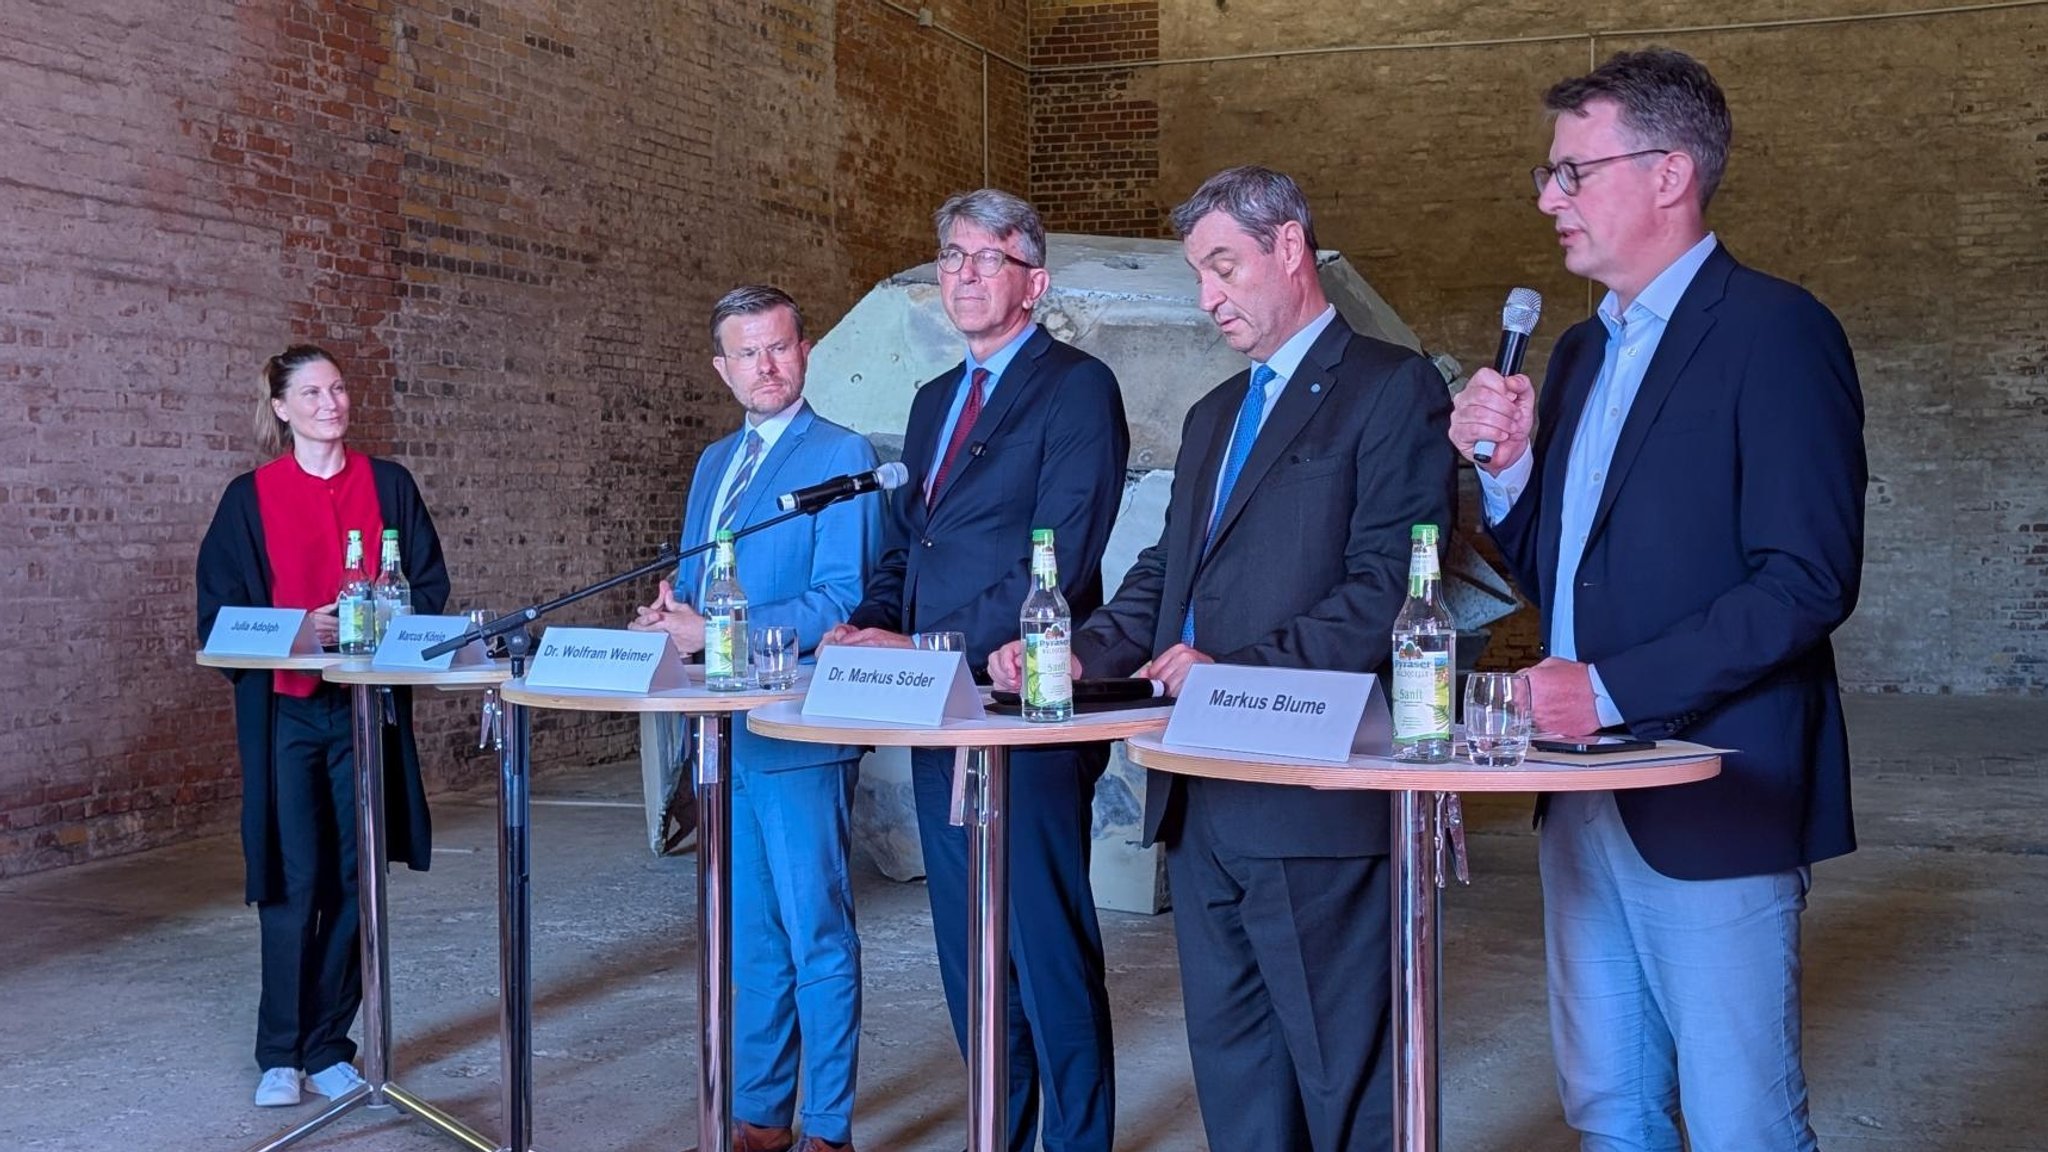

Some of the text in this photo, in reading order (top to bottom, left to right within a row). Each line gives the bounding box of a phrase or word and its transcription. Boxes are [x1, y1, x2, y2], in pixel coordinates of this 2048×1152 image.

[251, 621, 280, 634] Adolph
[543, 644, 653, 662] Dr. Wolfram Weimer
[828, 666, 936, 688] Dr. Markus Söder
[1209, 689, 1326, 715] Markus Blume
